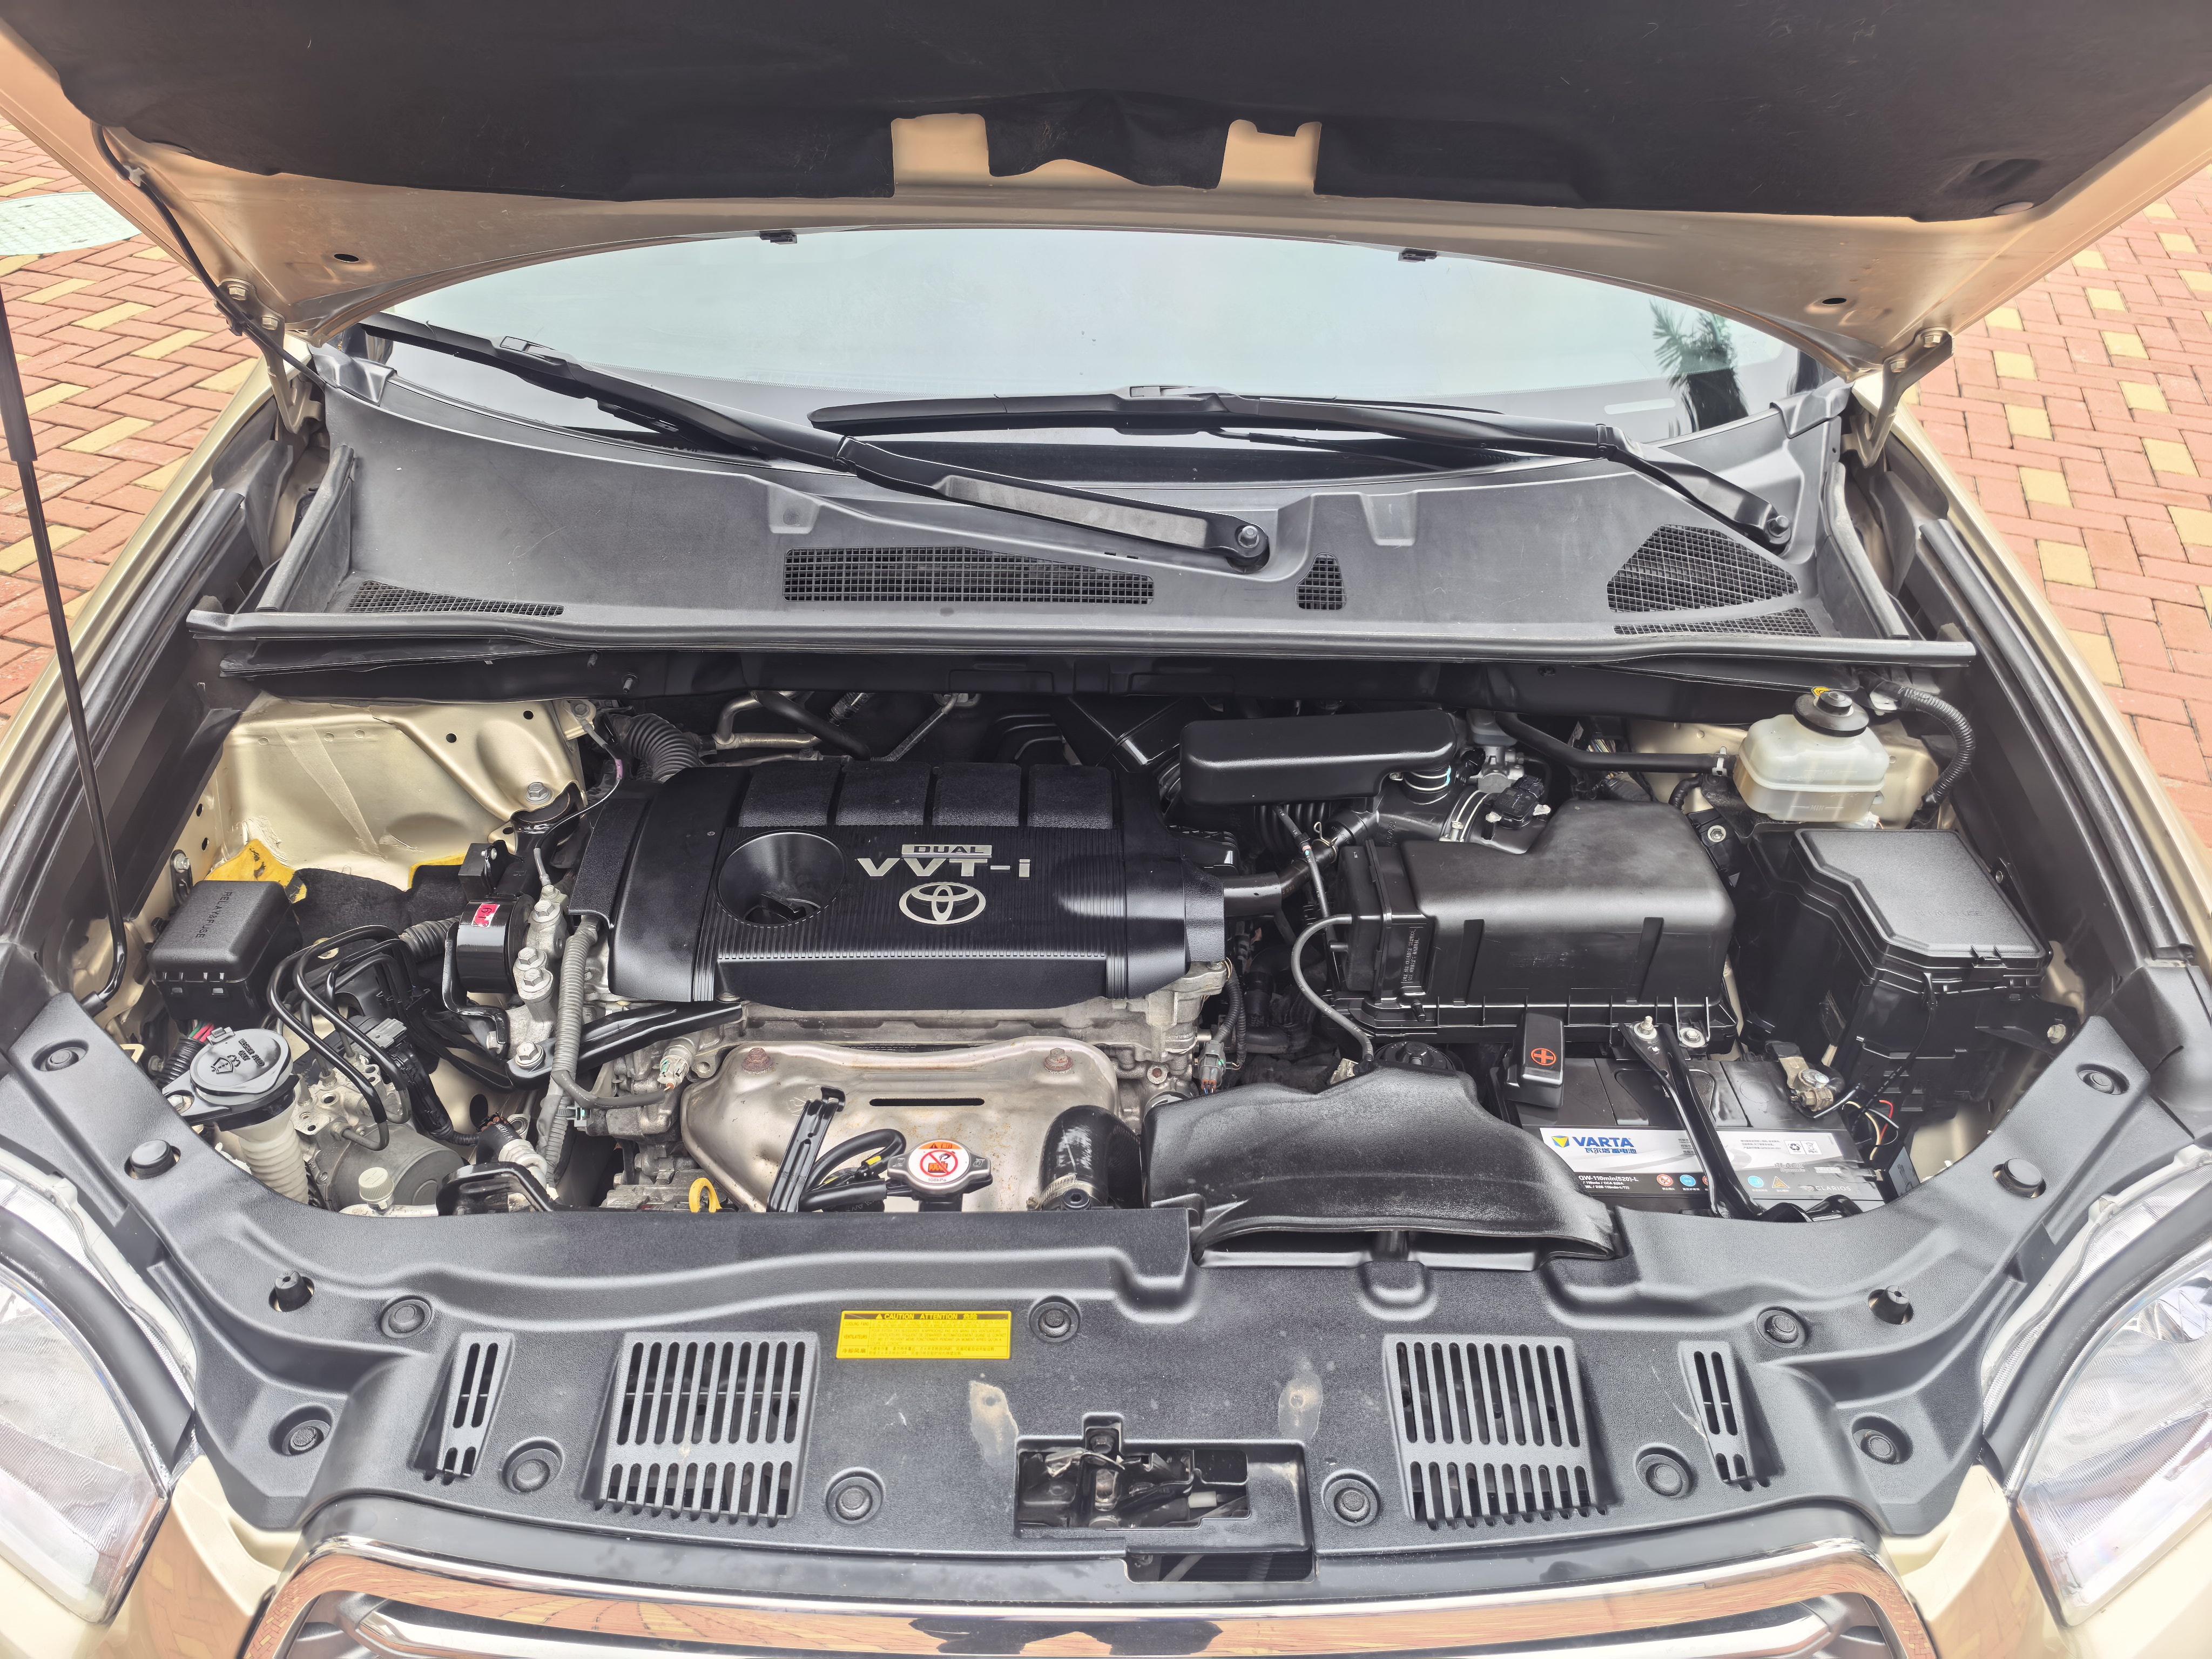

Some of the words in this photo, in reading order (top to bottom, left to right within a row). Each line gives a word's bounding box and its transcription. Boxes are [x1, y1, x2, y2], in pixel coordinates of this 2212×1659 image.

[913, 845, 984, 854] DUAL
[857, 858, 1030, 878] VVT-i
[195, 891, 233, 939] RELAY&FUSE
[1572, 1136, 1635, 1148] VARTA
